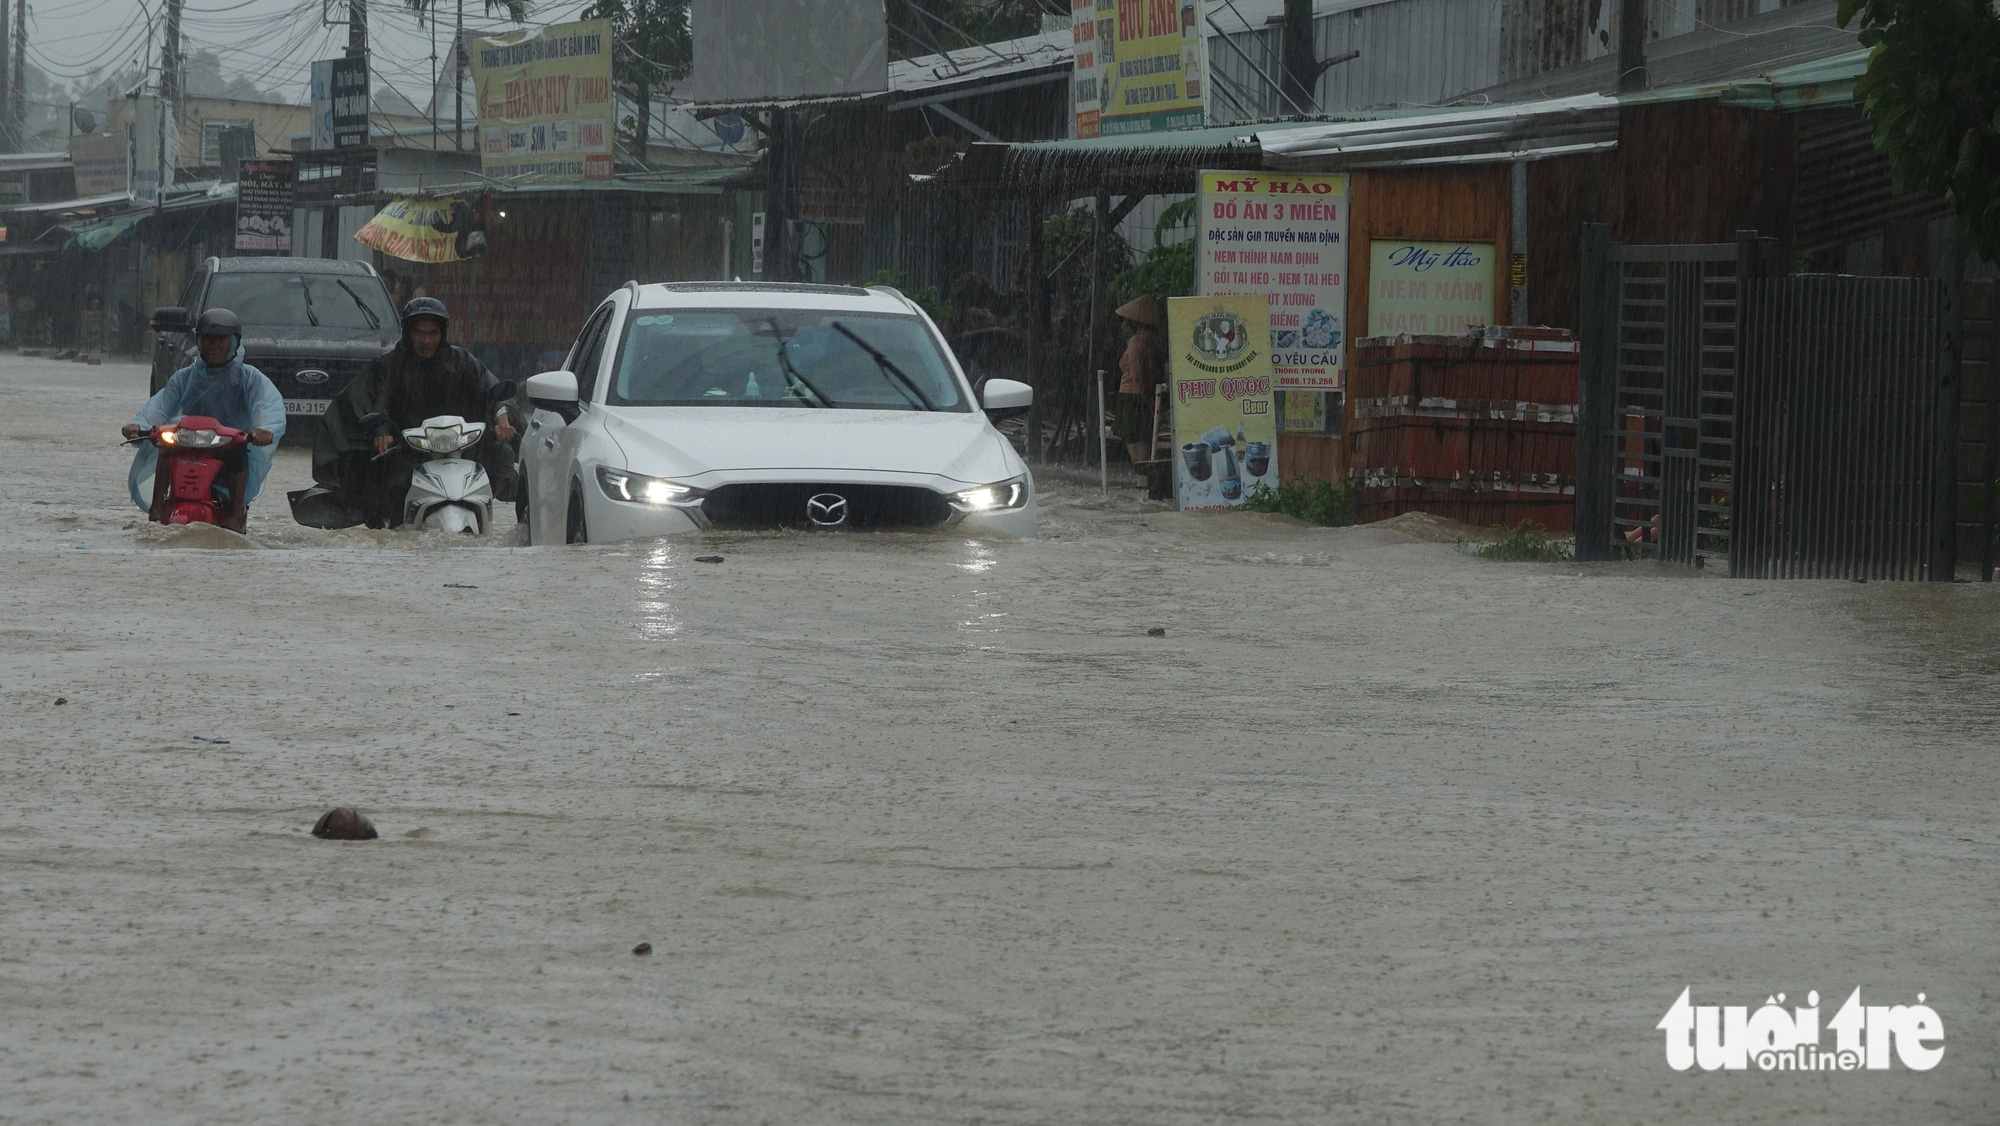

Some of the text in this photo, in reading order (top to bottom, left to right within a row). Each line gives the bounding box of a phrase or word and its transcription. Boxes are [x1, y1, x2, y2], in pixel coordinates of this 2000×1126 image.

[505, 68, 570, 119] HOÀNG HUY
[582, 77, 608, 104] YAMAHA
[1216, 177, 1332, 194] MỸ HẢO
[1213, 197, 1336, 220] ĐỒ ĂN 3 MIỀN
[1209, 228, 1225, 244] ĐẶC
[1228, 226, 1244, 241] SẢN
[1247, 231, 1262, 242] GIA
[1298, 232, 1317, 242] NAM
[1319, 229, 1340, 246] ĐỊNH
[1214, 249, 1319, 268] NEM THÍNH NAM ĐỊNH
[1388, 246, 1481, 272] Mỹ Hảo
[1233, 272, 1247, 284] TAI
[1251, 272, 1269, 284] HEO
[1279, 272, 1301, 286] NEM
[1304, 273, 1318, 286] TAI
[1321, 273, 1340, 286] HEO
[1268, 290, 1280, 306] ÚT
[1283, 293, 1315, 306] XƯƠNG
[1380, 280, 1427, 299] NEM
[1379, 312, 1427, 332] NAM
[1285, 352, 1306, 365] YÊU
[1310, 351, 1337, 365] CẦU
[304, 372, 321, 380] Ford
[1178, 379, 1216, 403] PHU
[1220, 376, 1270, 400] QUOC
[1242, 399, 1268, 414] Beer
